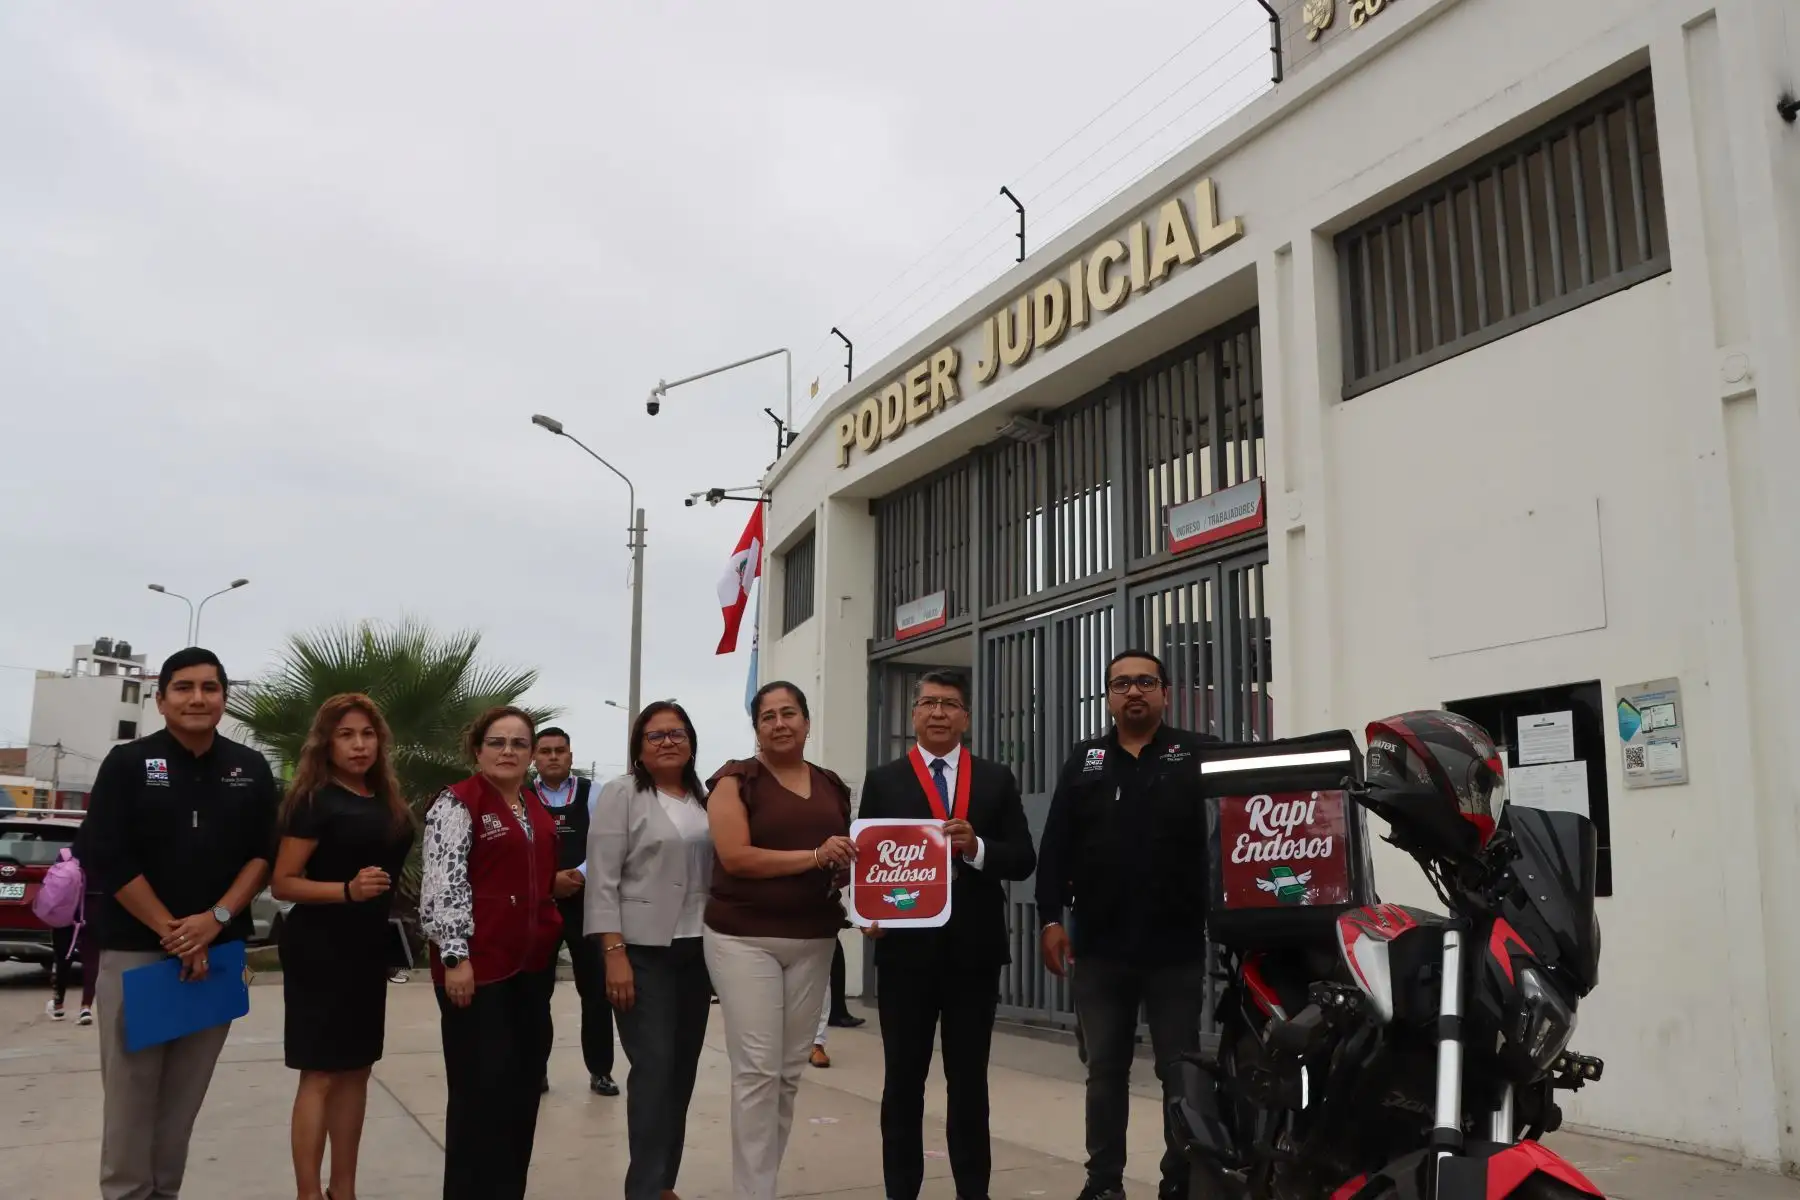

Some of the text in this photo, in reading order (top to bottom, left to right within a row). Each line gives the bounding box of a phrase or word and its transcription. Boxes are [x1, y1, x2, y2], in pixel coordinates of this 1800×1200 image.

[835, 177, 1244, 468] PODER JUDICIAL
[1175, 520, 1201, 538] INGRESO
[1207, 500, 1256, 526] TRABAJADORES
[1244, 790, 1318, 838] Rapi
[876, 838, 928, 868] Rapi
[1231, 833, 1333, 864] Endosos
[865, 864, 937, 884] Endosos
[0, 886, 23, 896] T-553
